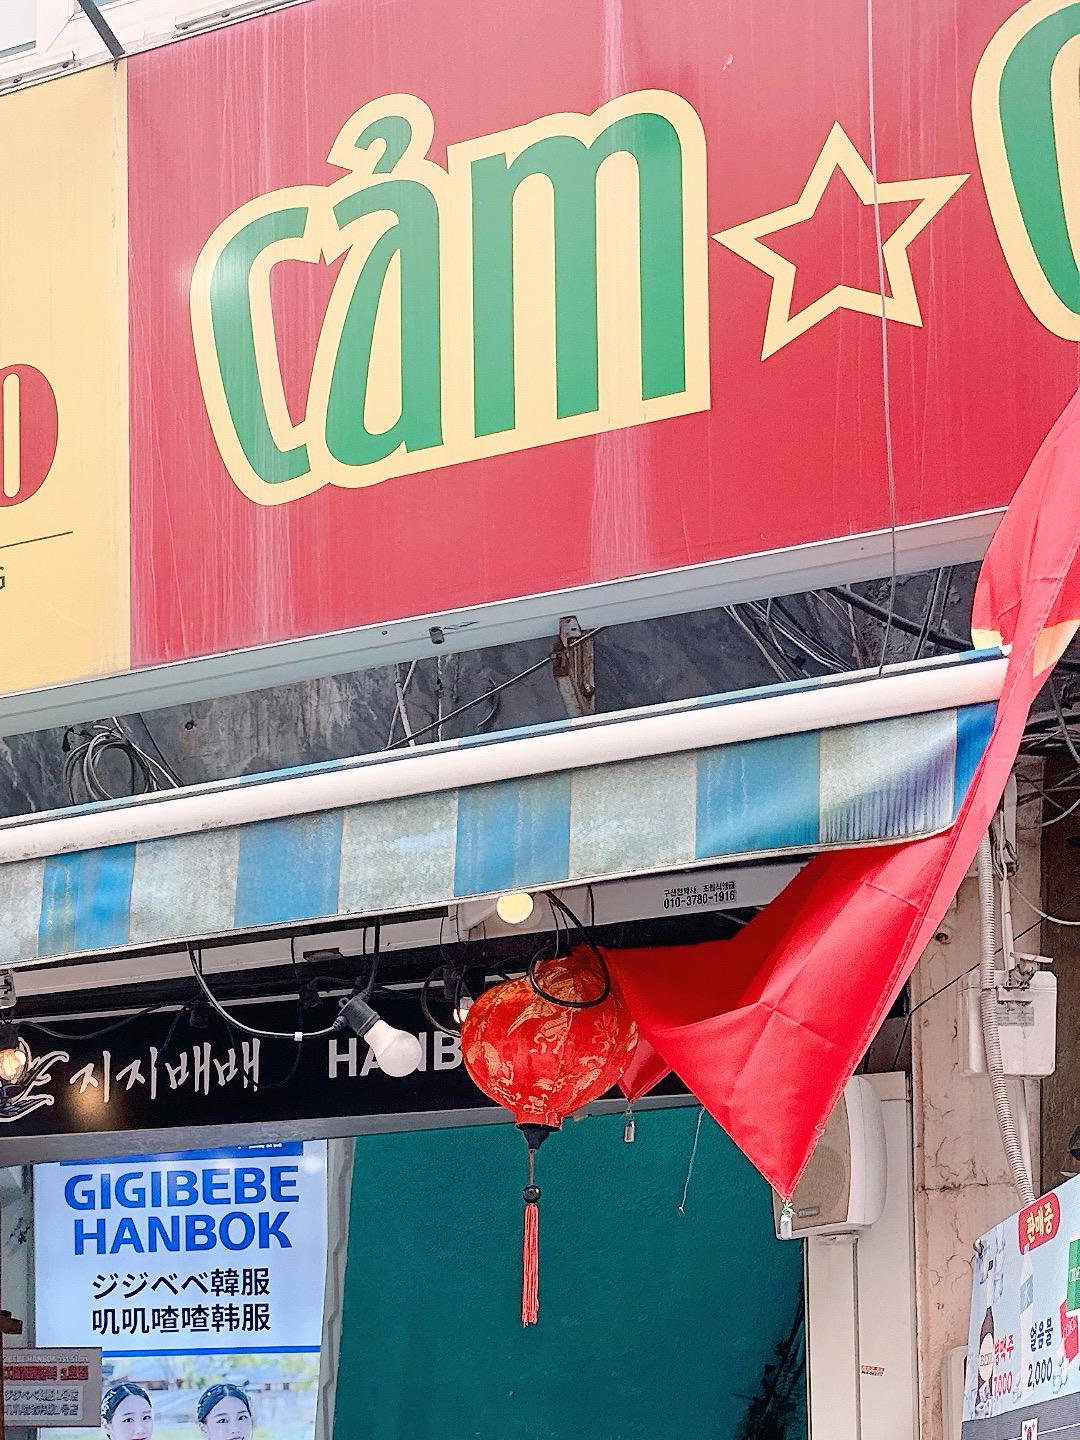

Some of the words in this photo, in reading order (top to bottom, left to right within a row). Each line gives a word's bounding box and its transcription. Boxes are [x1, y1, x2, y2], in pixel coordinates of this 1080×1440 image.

[64, 1166, 299, 1210] GIGIBEBE
[73, 1211, 292, 1255] HANBOK
[92, 1268, 271, 1297] ジジベベ韓服
[92, 1304, 271, 1334] 叽叽喳喳韩服
[1028, 1357, 1053, 1389] 2,000
